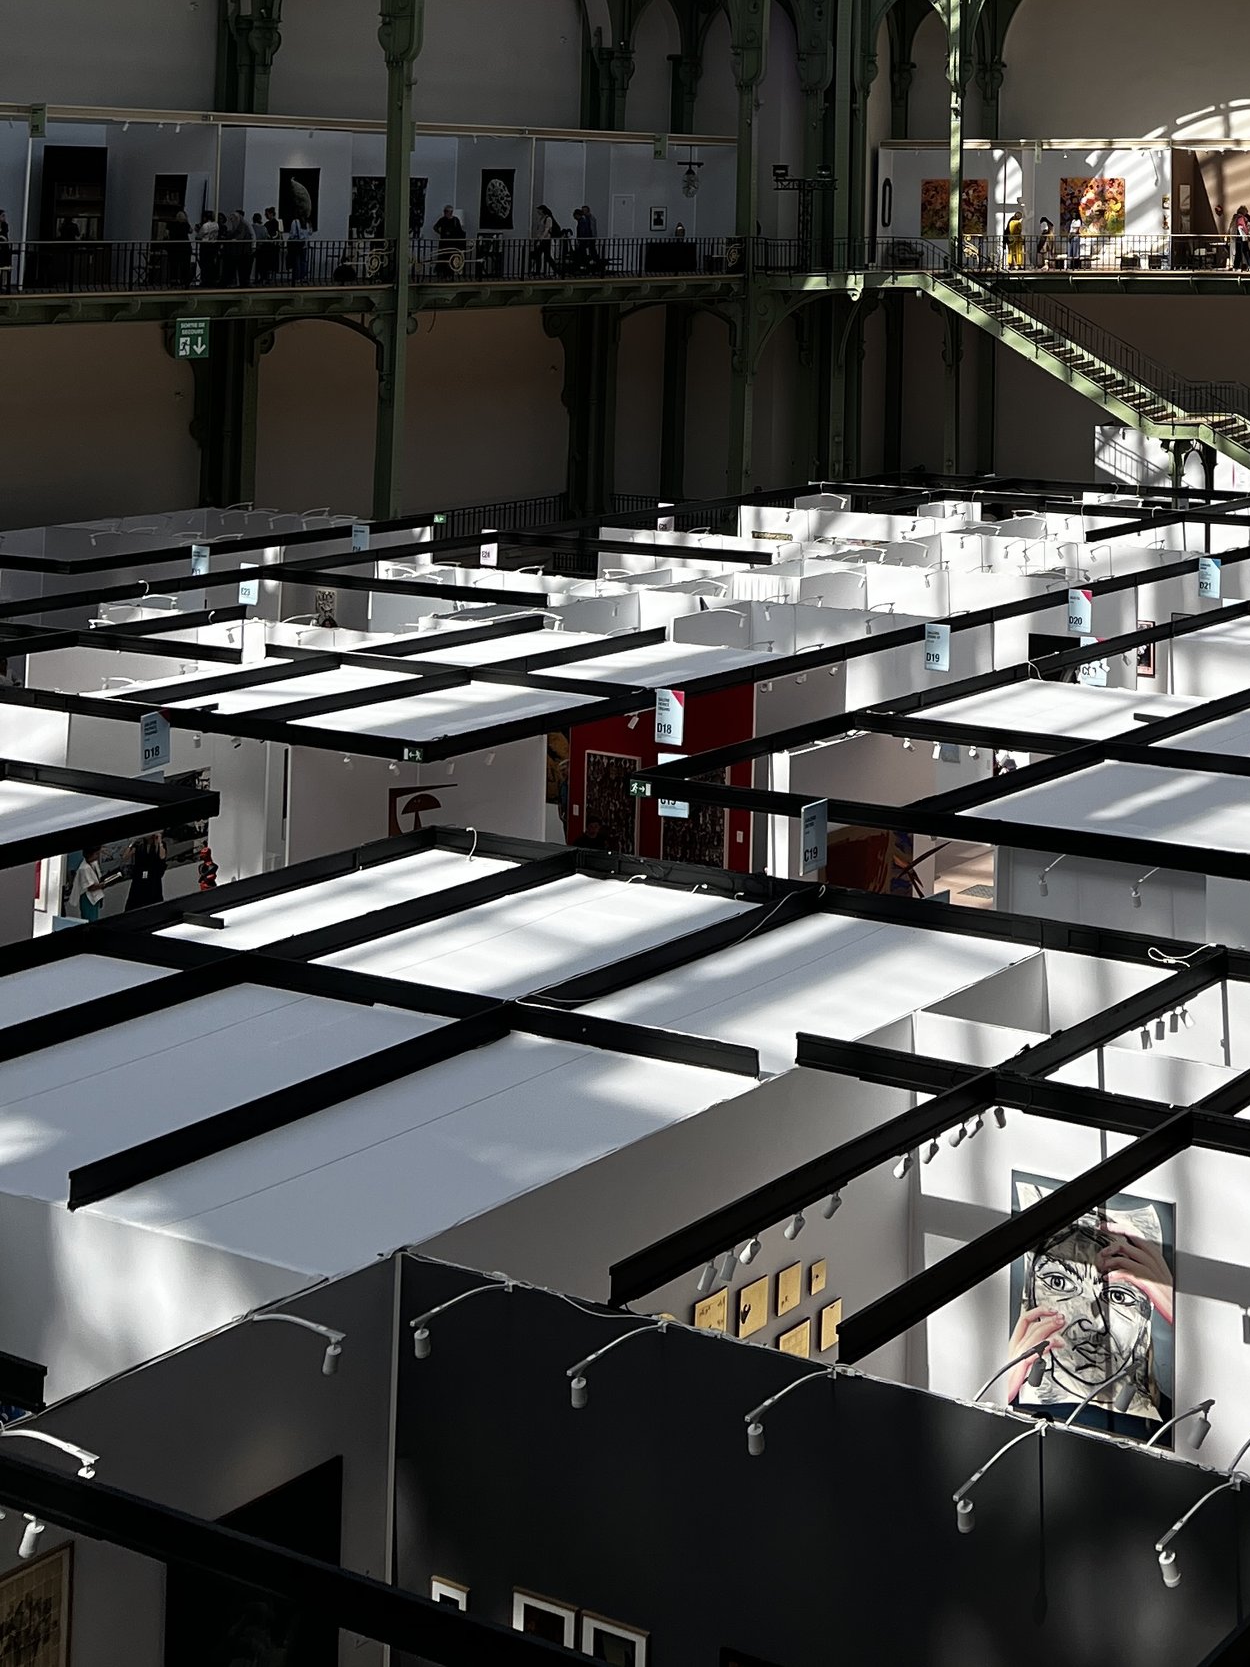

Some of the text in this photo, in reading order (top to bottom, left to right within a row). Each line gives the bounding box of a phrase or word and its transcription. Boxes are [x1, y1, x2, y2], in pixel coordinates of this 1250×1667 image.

[1199, 581, 1212, 590] D21
[1068, 615, 1083, 626] D20
[926, 652, 940, 663] D19
[657, 722, 672, 735] D18
[144, 745, 160, 760] D18
[803, 846, 818, 863] C19
